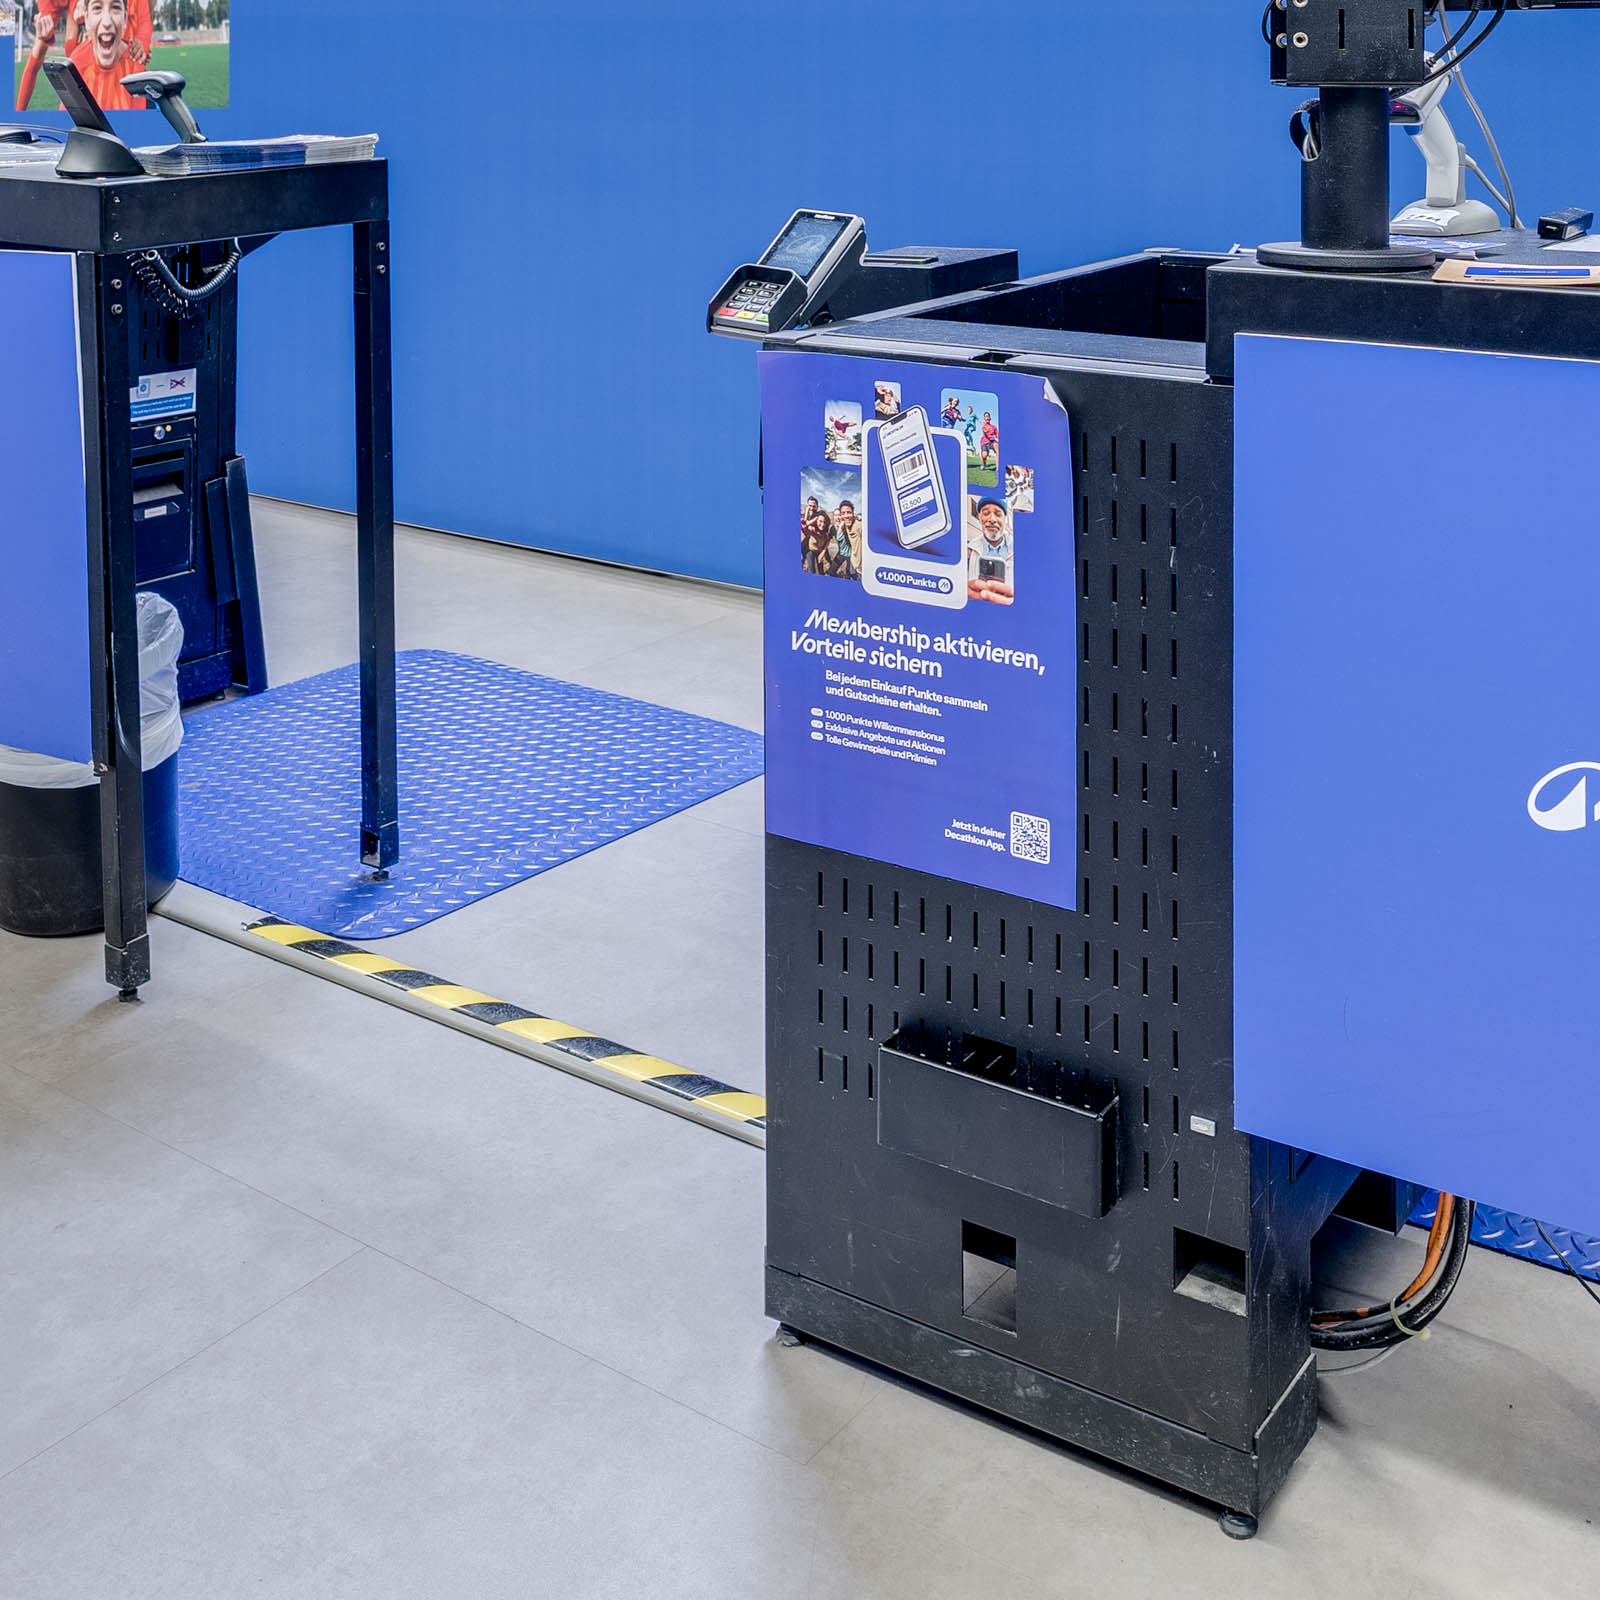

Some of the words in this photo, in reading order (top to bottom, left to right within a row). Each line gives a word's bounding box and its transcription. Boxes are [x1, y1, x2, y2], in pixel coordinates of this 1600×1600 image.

[877, 571, 906, 584] +1.000
[906, 575, 937, 589] Punkte
[791, 630, 867, 663] Vorteile
[868, 646, 943, 678] sichern
[804, 608, 931, 653] Membership
[933, 632, 1046, 676] aktivieren,
[825, 669, 842, 682] Bei
[840, 672, 871, 689] jedem
[871, 678, 908, 695] Einkauf
[907, 686, 944, 703] Punkte
[943, 695, 988, 712] sammeln
[825, 685, 844, 697] und
[844, 688, 899, 708] Gutscheine
[899, 700, 942, 717] erhalten.
[824, 709, 847, 722] 1.000
[846, 714, 873, 728] Punkte
[873, 719, 945, 743] Willkommensbonus
[824, 721, 858, 737] Exklusive
[859, 728, 896, 745] Angebote
[895, 737, 911, 749] und
[911, 739, 946, 756] Aktionen
[824, 733, 842, 745] Tolle
[890, 747, 906, 760] und
[906, 751, 937, 766] Prämien
[944, 828, 986, 847] Decathlon
[951, 818, 972, 832] Jetzt
[972, 823, 980, 834] in
[980, 825, 1007, 840] deiner
